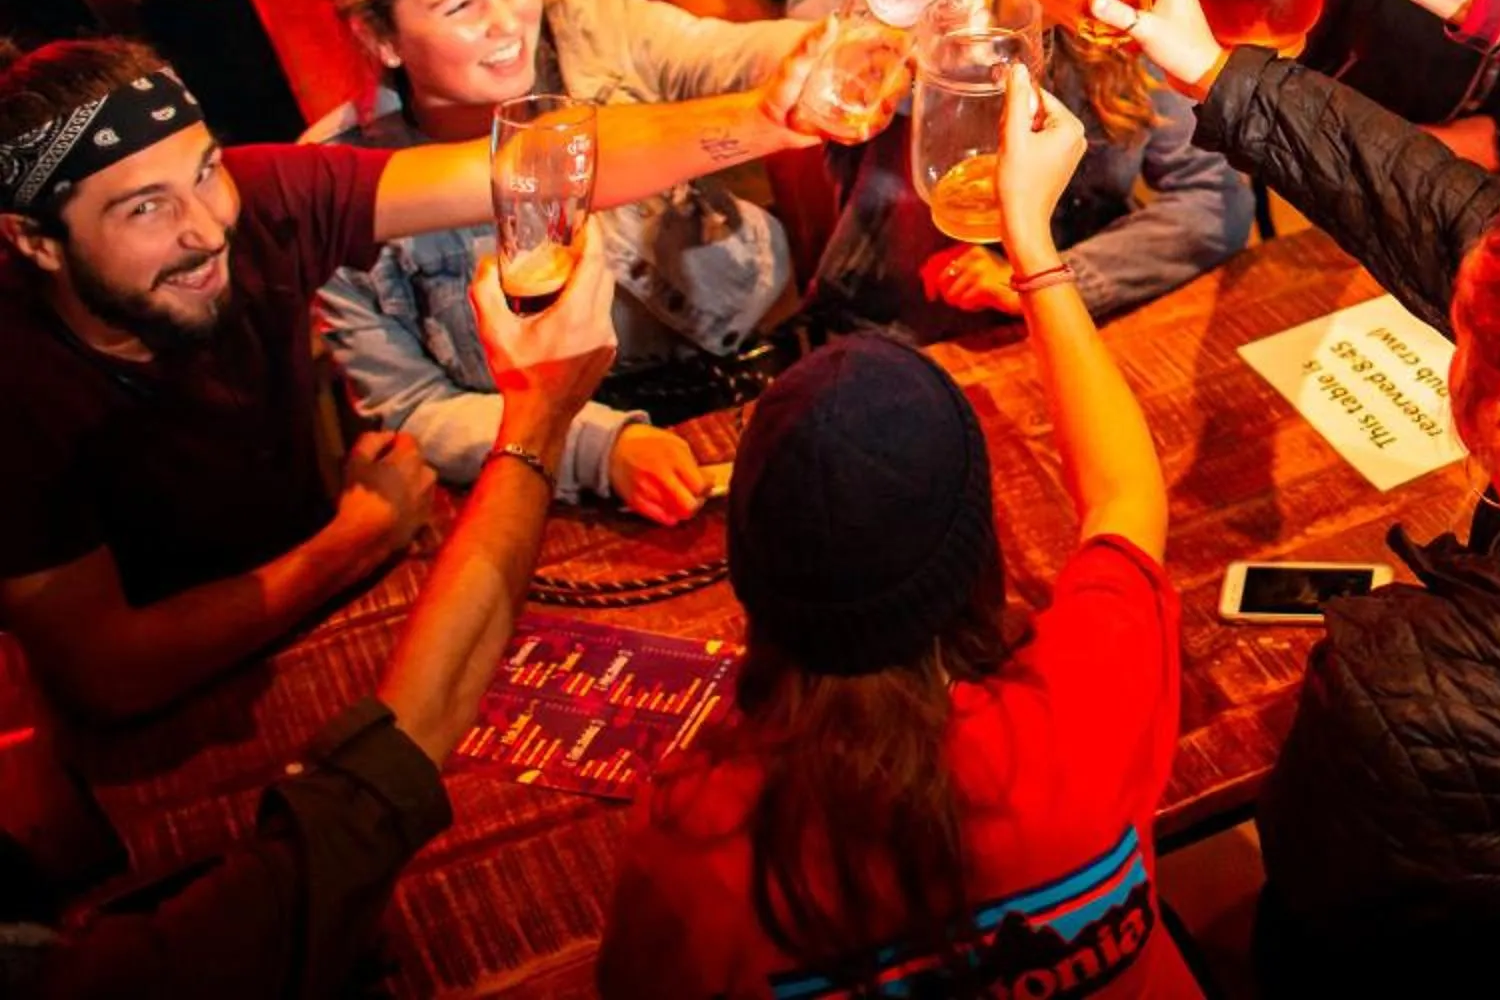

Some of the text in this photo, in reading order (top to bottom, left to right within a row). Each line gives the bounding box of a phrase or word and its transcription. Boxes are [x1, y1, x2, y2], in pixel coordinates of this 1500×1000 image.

[1366, 328, 1420, 365] crawl
[1302, 360, 1397, 449] This table is
[1363, 373, 1443, 437] reserved
